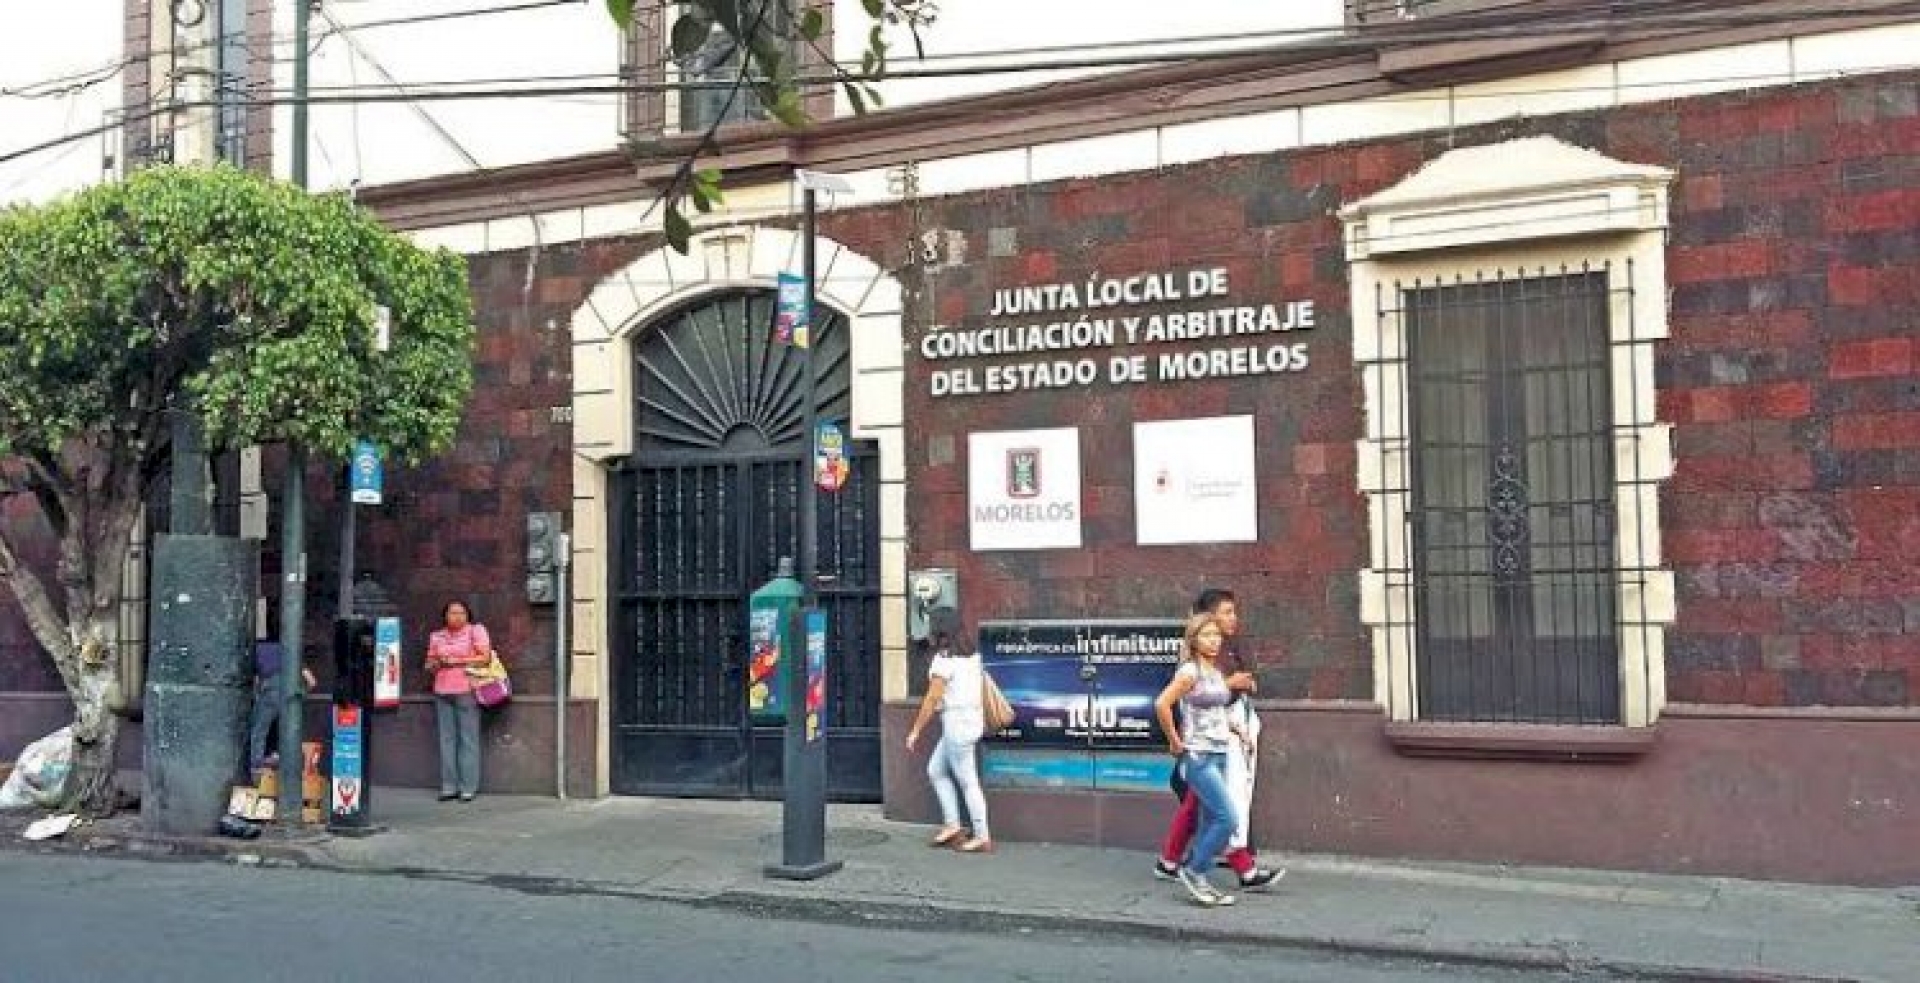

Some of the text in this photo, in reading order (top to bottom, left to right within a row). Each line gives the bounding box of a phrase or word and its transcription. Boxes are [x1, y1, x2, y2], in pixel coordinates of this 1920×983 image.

[990, 268, 1229, 316] JUNTA LOCAL DE
[920, 300, 1316, 359] CONCILIACIÓN Y ARBITRAJE
[931, 342, 1309, 396] DEL ESTADO DE MORELOS
[974, 502, 1075, 523] MORELOS
[1077, 633, 1184, 655] infinitum
